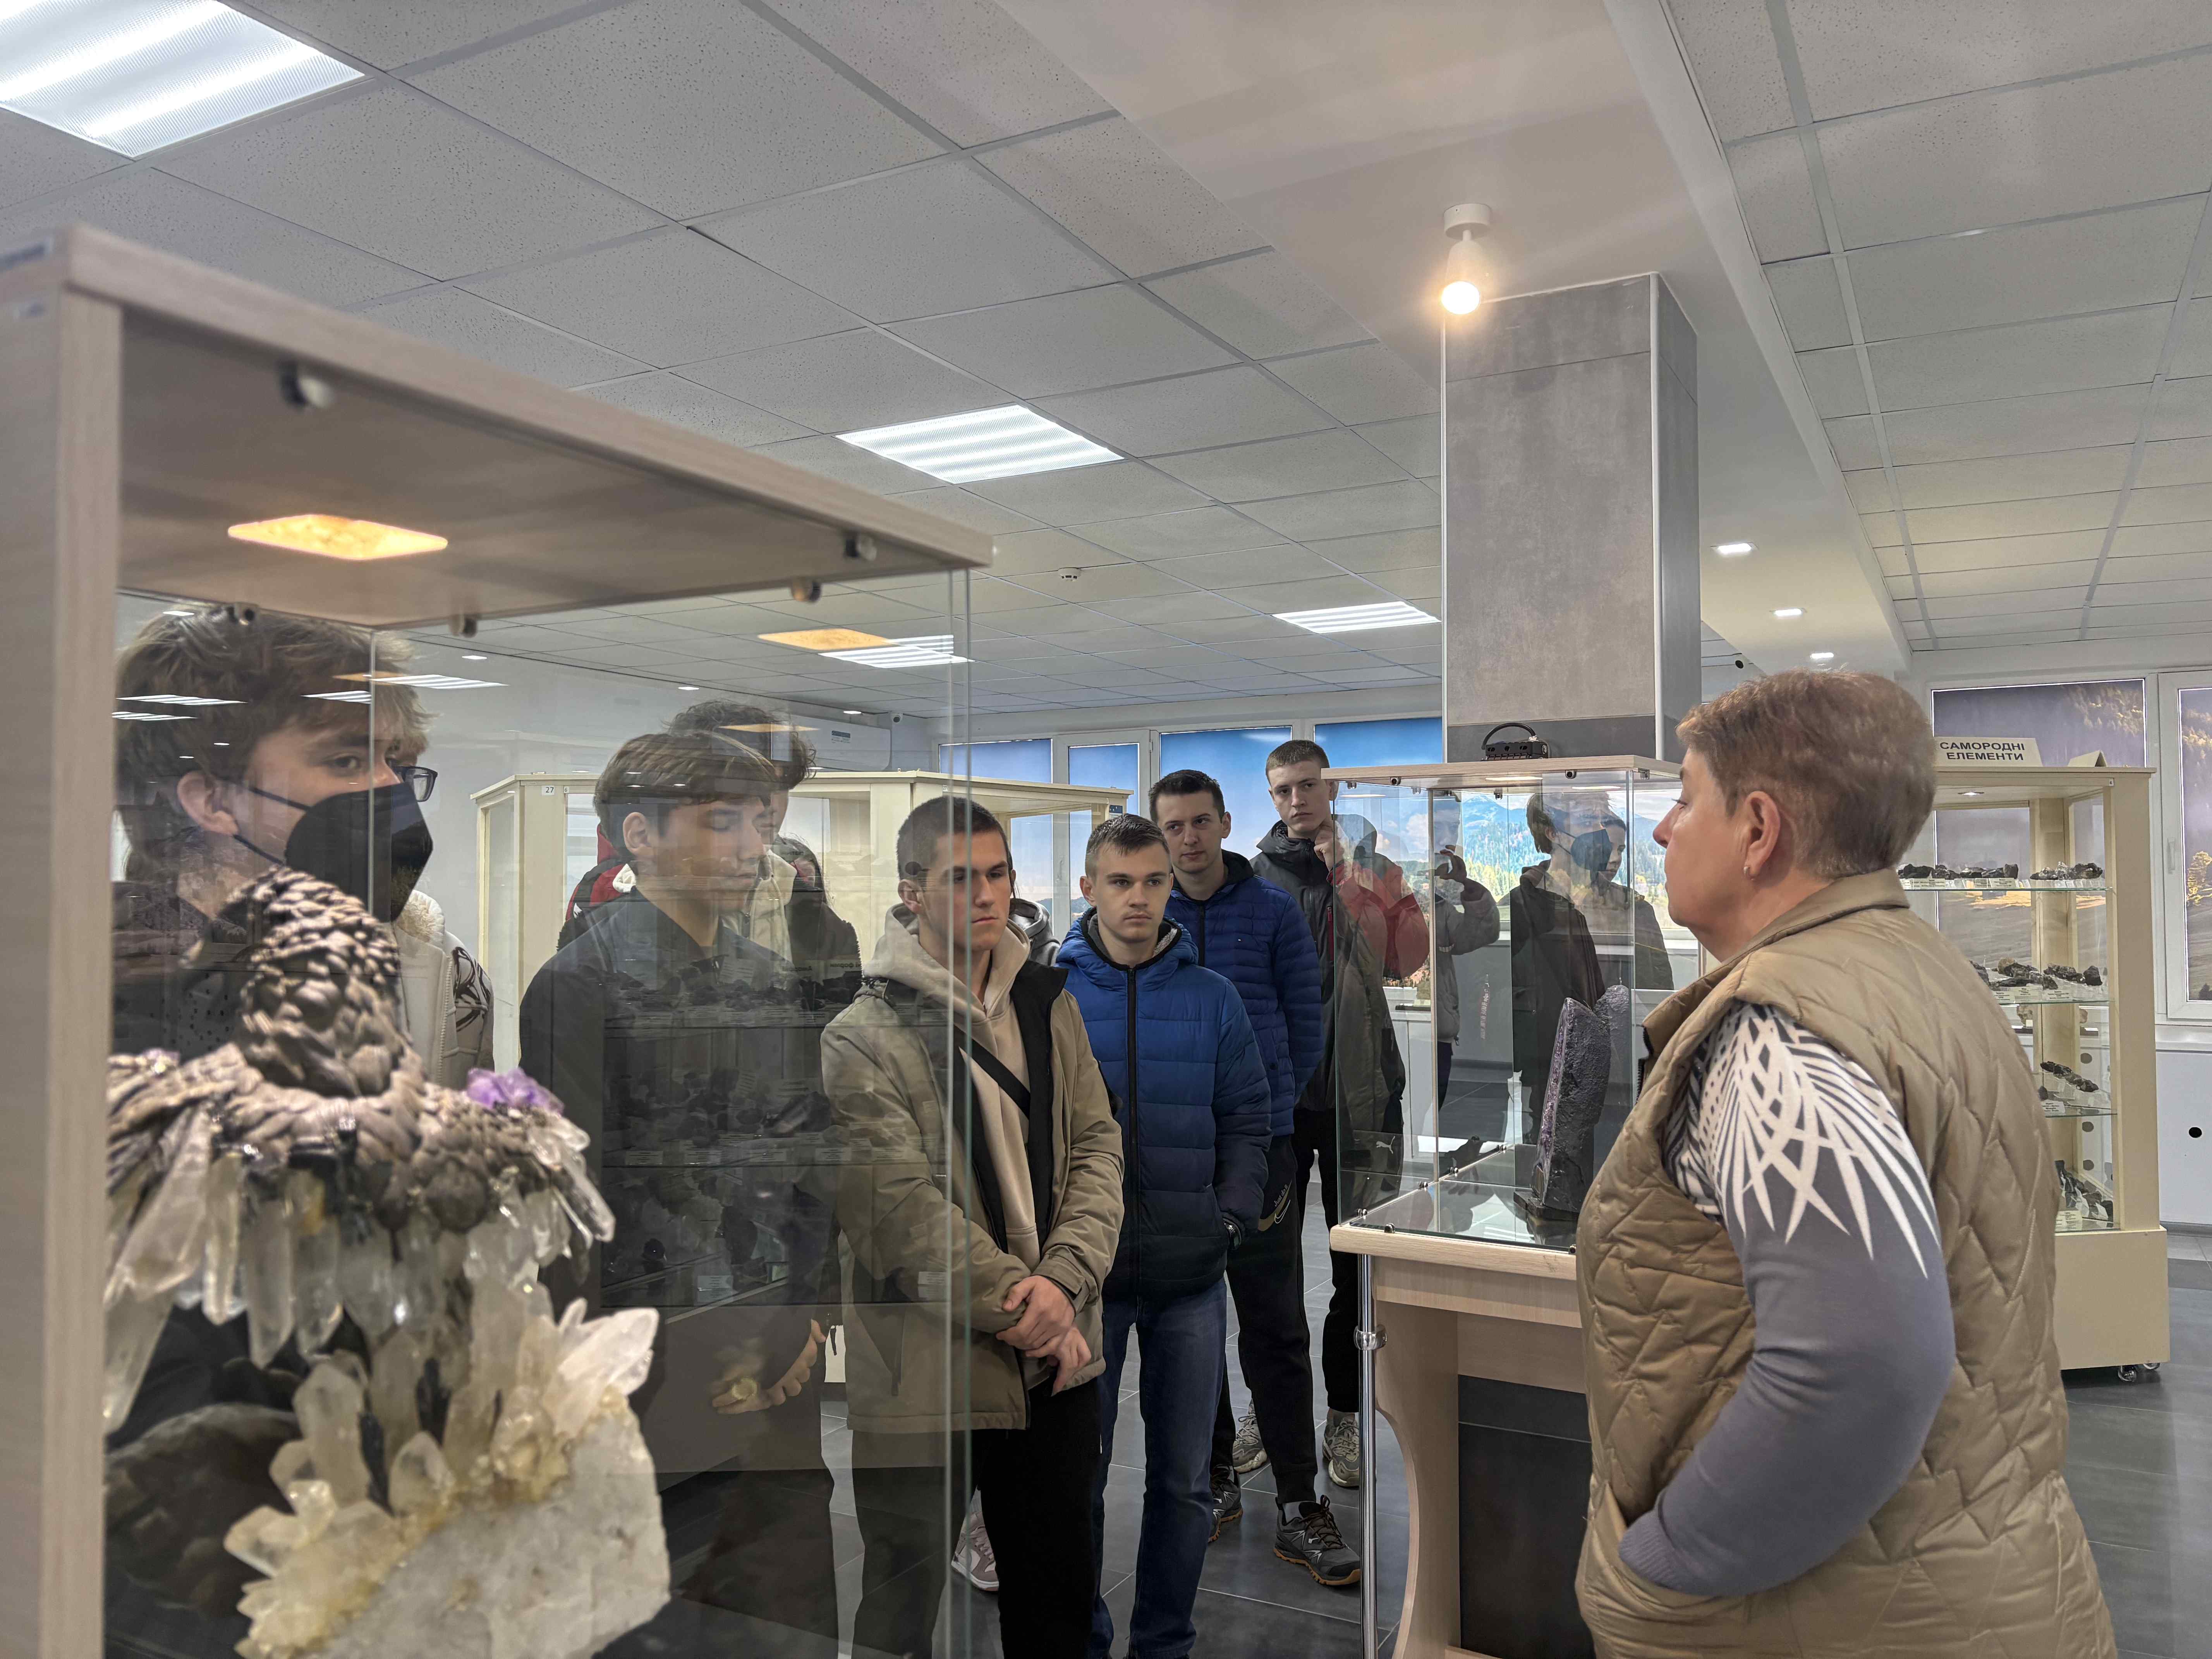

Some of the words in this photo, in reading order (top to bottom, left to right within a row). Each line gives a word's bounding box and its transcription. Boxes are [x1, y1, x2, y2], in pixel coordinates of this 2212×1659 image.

[1940, 742, 2025, 752] САМОРОДНІ
[1946, 752, 2024, 761] ЕЛЕМЕНТИ
[1274, 1195, 1282, 1207] Just
